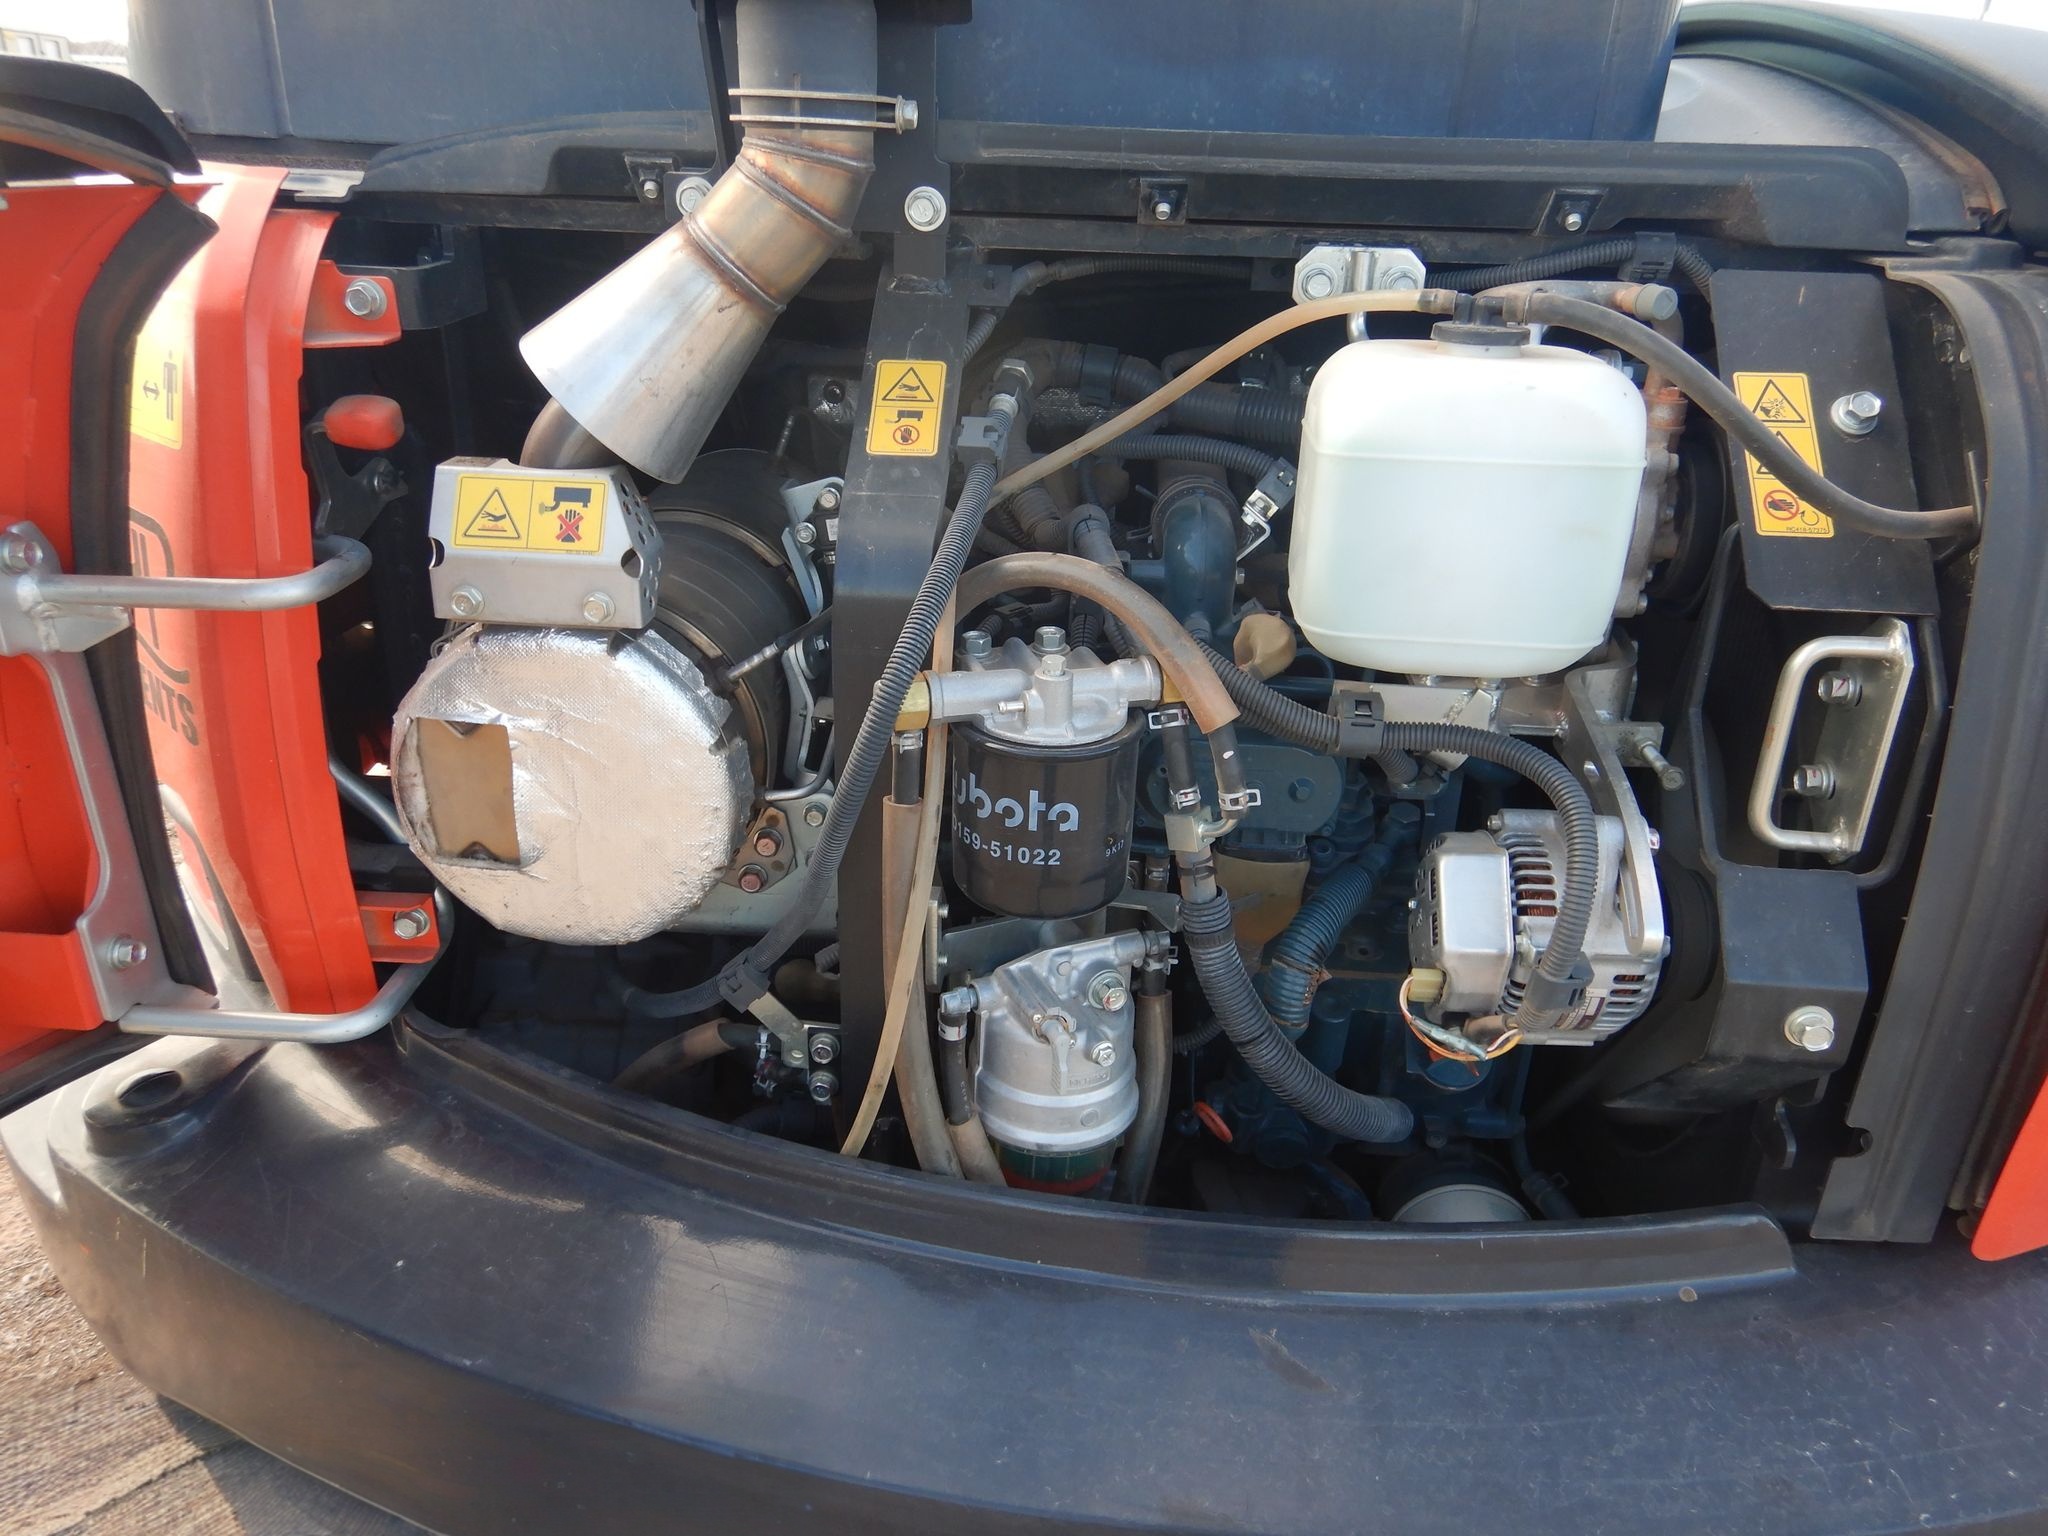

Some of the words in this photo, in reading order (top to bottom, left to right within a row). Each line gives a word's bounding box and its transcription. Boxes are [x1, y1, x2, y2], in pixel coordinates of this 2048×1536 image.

[140, 663, 199, 746] ENTS
[954, 771, 1079, 832] ubota
[952, 813, 1061, 866] 159-51022
